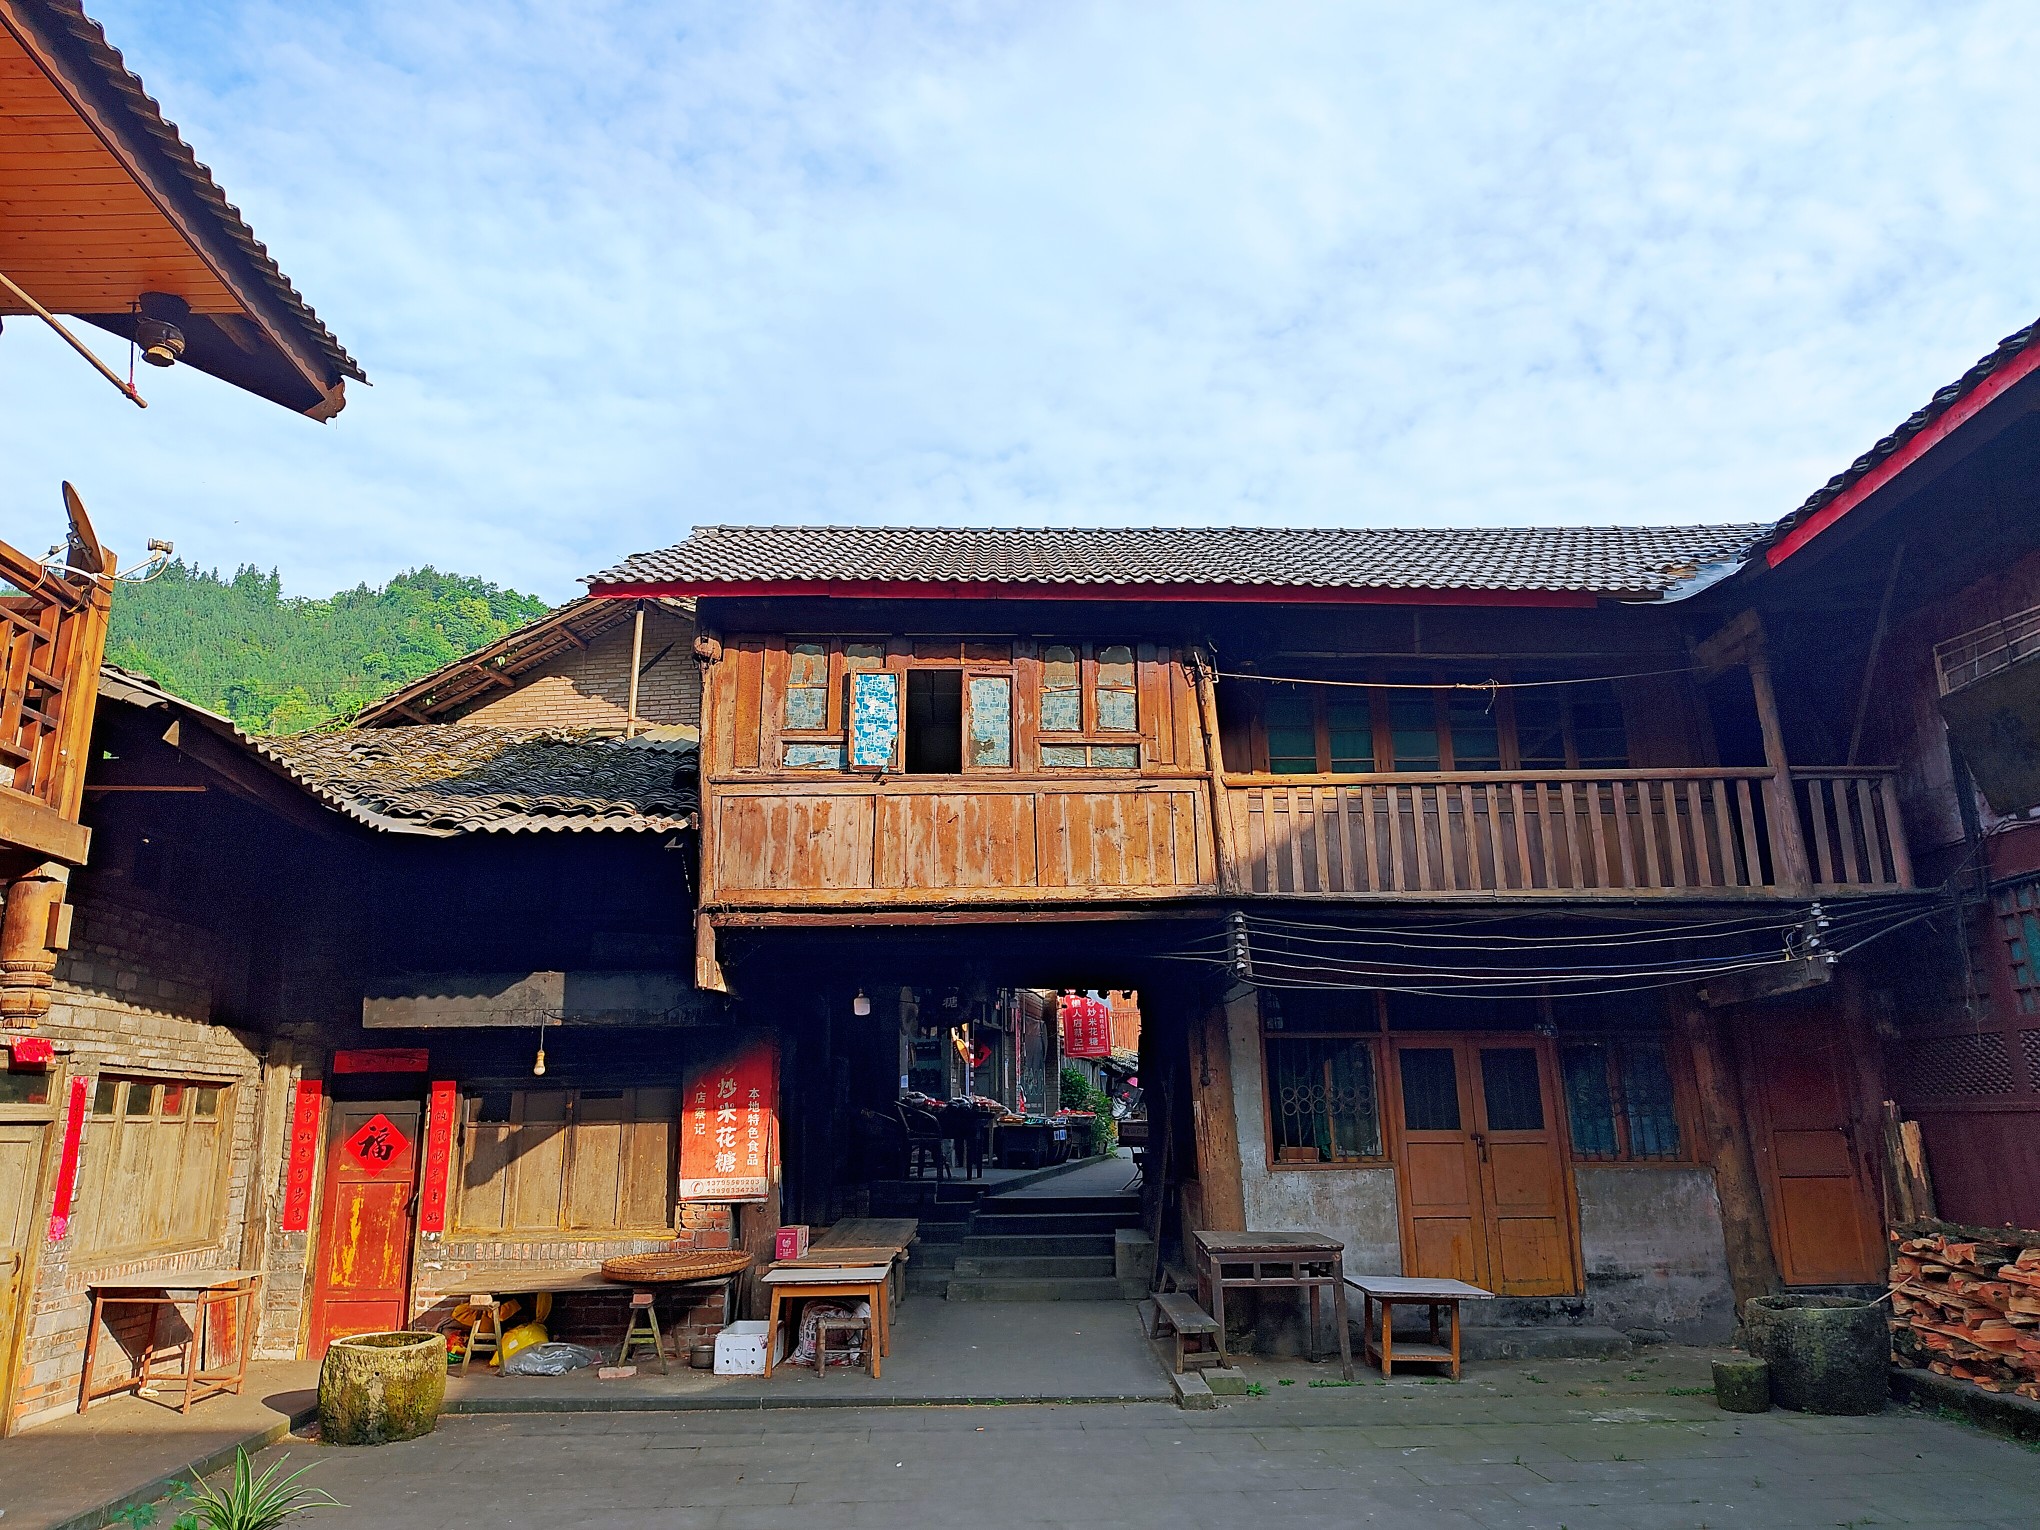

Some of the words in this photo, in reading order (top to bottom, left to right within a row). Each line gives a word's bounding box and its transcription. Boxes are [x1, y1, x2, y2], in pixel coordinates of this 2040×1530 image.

[357, 1125, 395, 1161] 福
[715, 1072, 737, 1173] 炒米花糖
[746, 1087, 760, 1167] 本地特色食品
